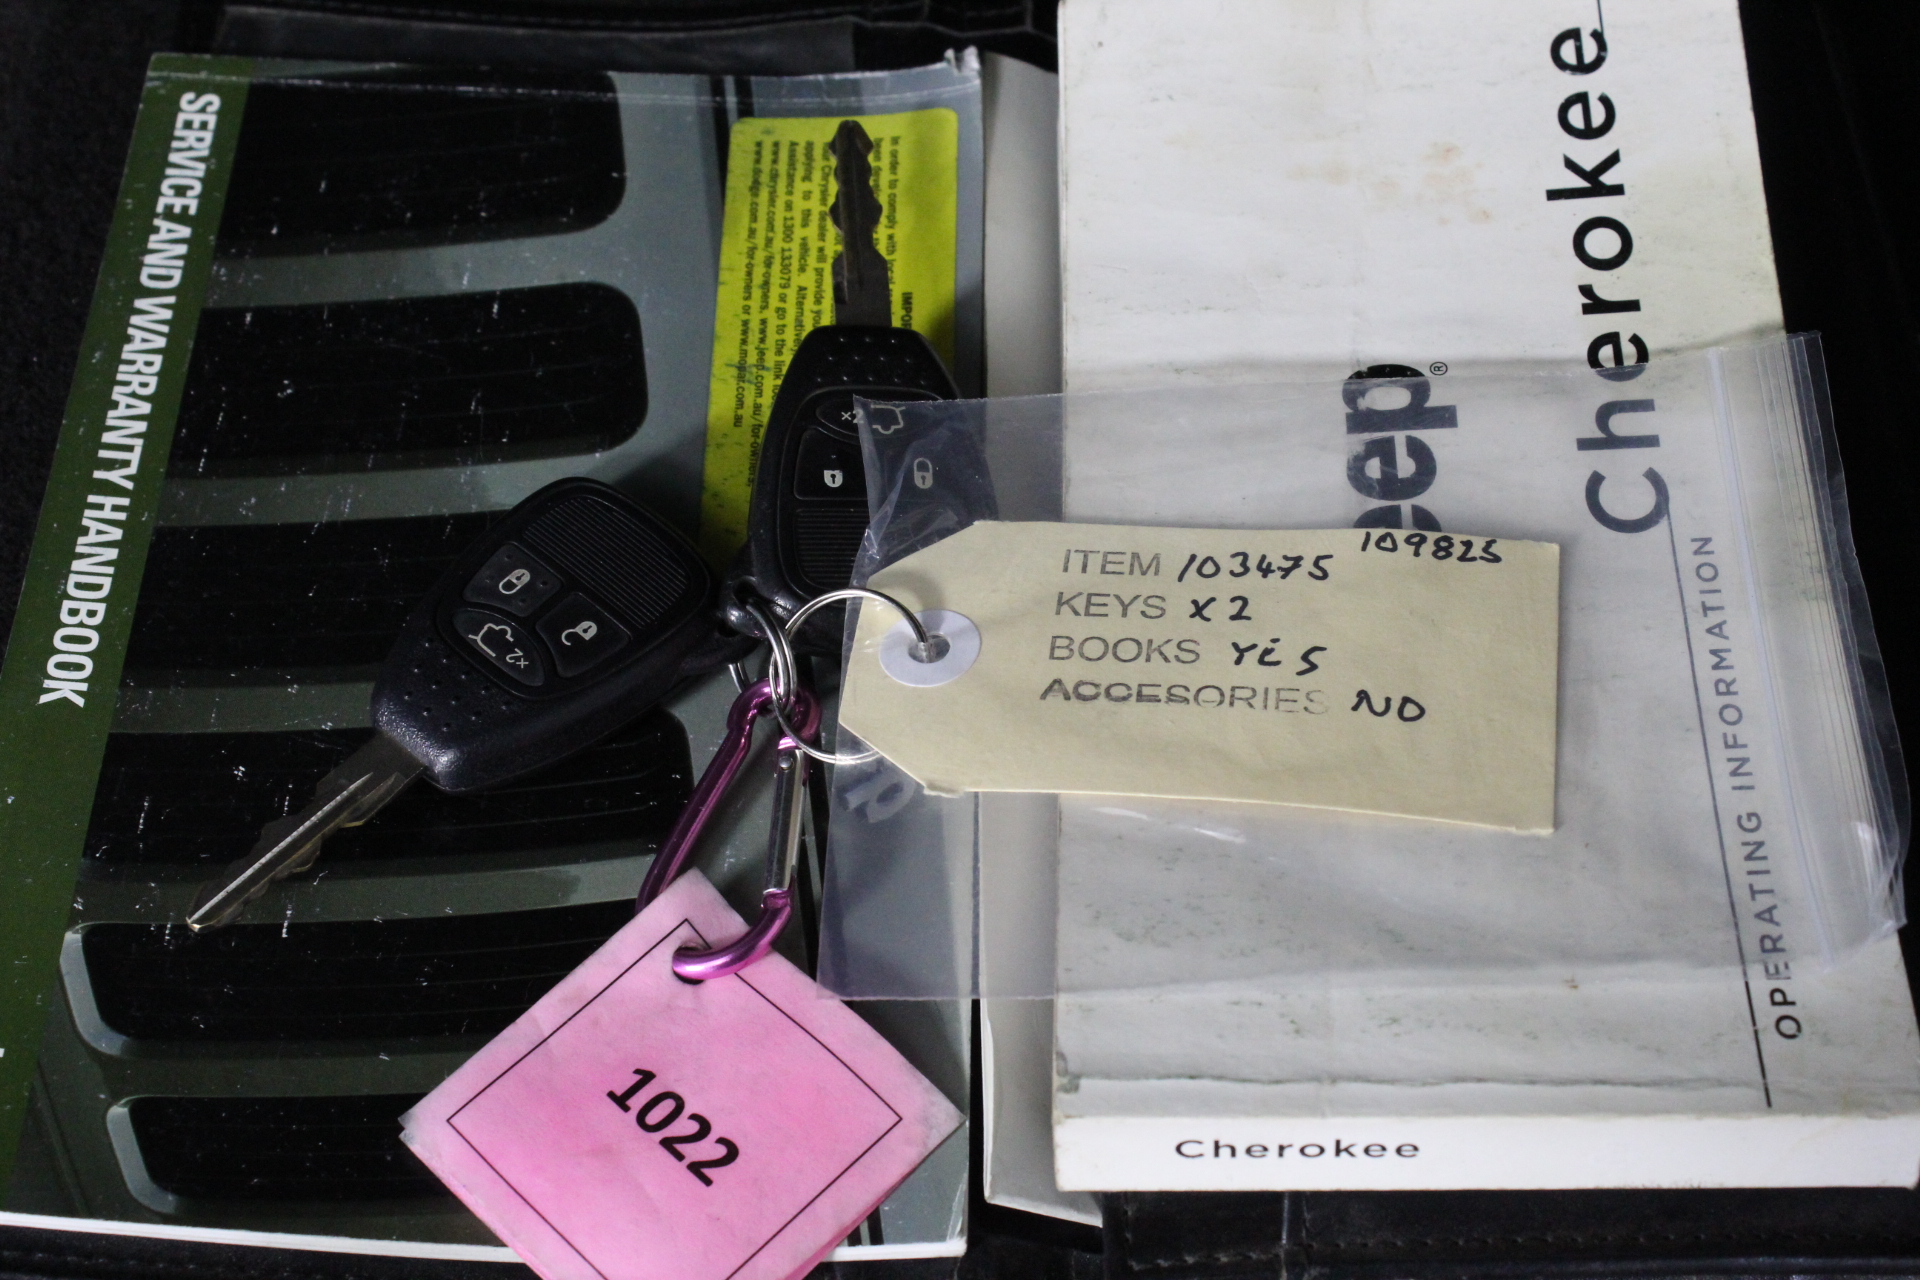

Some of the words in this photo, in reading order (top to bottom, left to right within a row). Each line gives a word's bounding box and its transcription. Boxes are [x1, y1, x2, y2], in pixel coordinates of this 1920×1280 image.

[155, 91, 221, 216] SERVICE
[785, 141, 800, 196] Assistance
[800, 141, 815, 182] applying
[888, 149, 900, 176] order
[801, 190, 813, 201] to
[817, 165, 833, 208] Chrysler
[888, 179, 899, 190] to
[784, 199, 794, 212] on
[800, 208, 813, 229] this
[884, 192, 898, 230] comply
[782, 215, 795, 243] 1300
[817, 210, 831, 242] dealer
[139, 217, 192, 290] AND
[797, 236, 810, 276] vehicle.
[816, 245, 829, 264] will
[885, 232, 897, 256] with
[779, 247, 793, 289] 133079
[1545, 27, 1671, 535] Cherokee
[778, 292, 788, 304] or
[813, 267, 827, 307] provide
[741, 304, 752, 316] or
[774, 306, 788, 321] go
[775, 324, 787, 336] to
[774, 339, 787, 357] the
[733, 318, 751, 428] www.mopar.com.au
[92, 295, 177, 491] WARRANTY
[1359, 530, 1503, 564] 109825
[1061, 548, 1161, 577] ITEM
[1176, 551, 1334, 583] 103475
[36, 494, 131, 708] HANDBOOK
[1053, 591, 1167, 620] KEYS
[1047, 634, 1201, 664] BOOKS
[1691, 535, 1752, 793] INFORMATION
[1039, 677, 1330, 716] ACCESORIES
[1350, 689, 1427, 723] NO
[1739, 811, 1803, 1041] OPERATING
[606, 1068, 740, 1187] 1022
[1175, 1138, 1420, 1160] Cherokee
